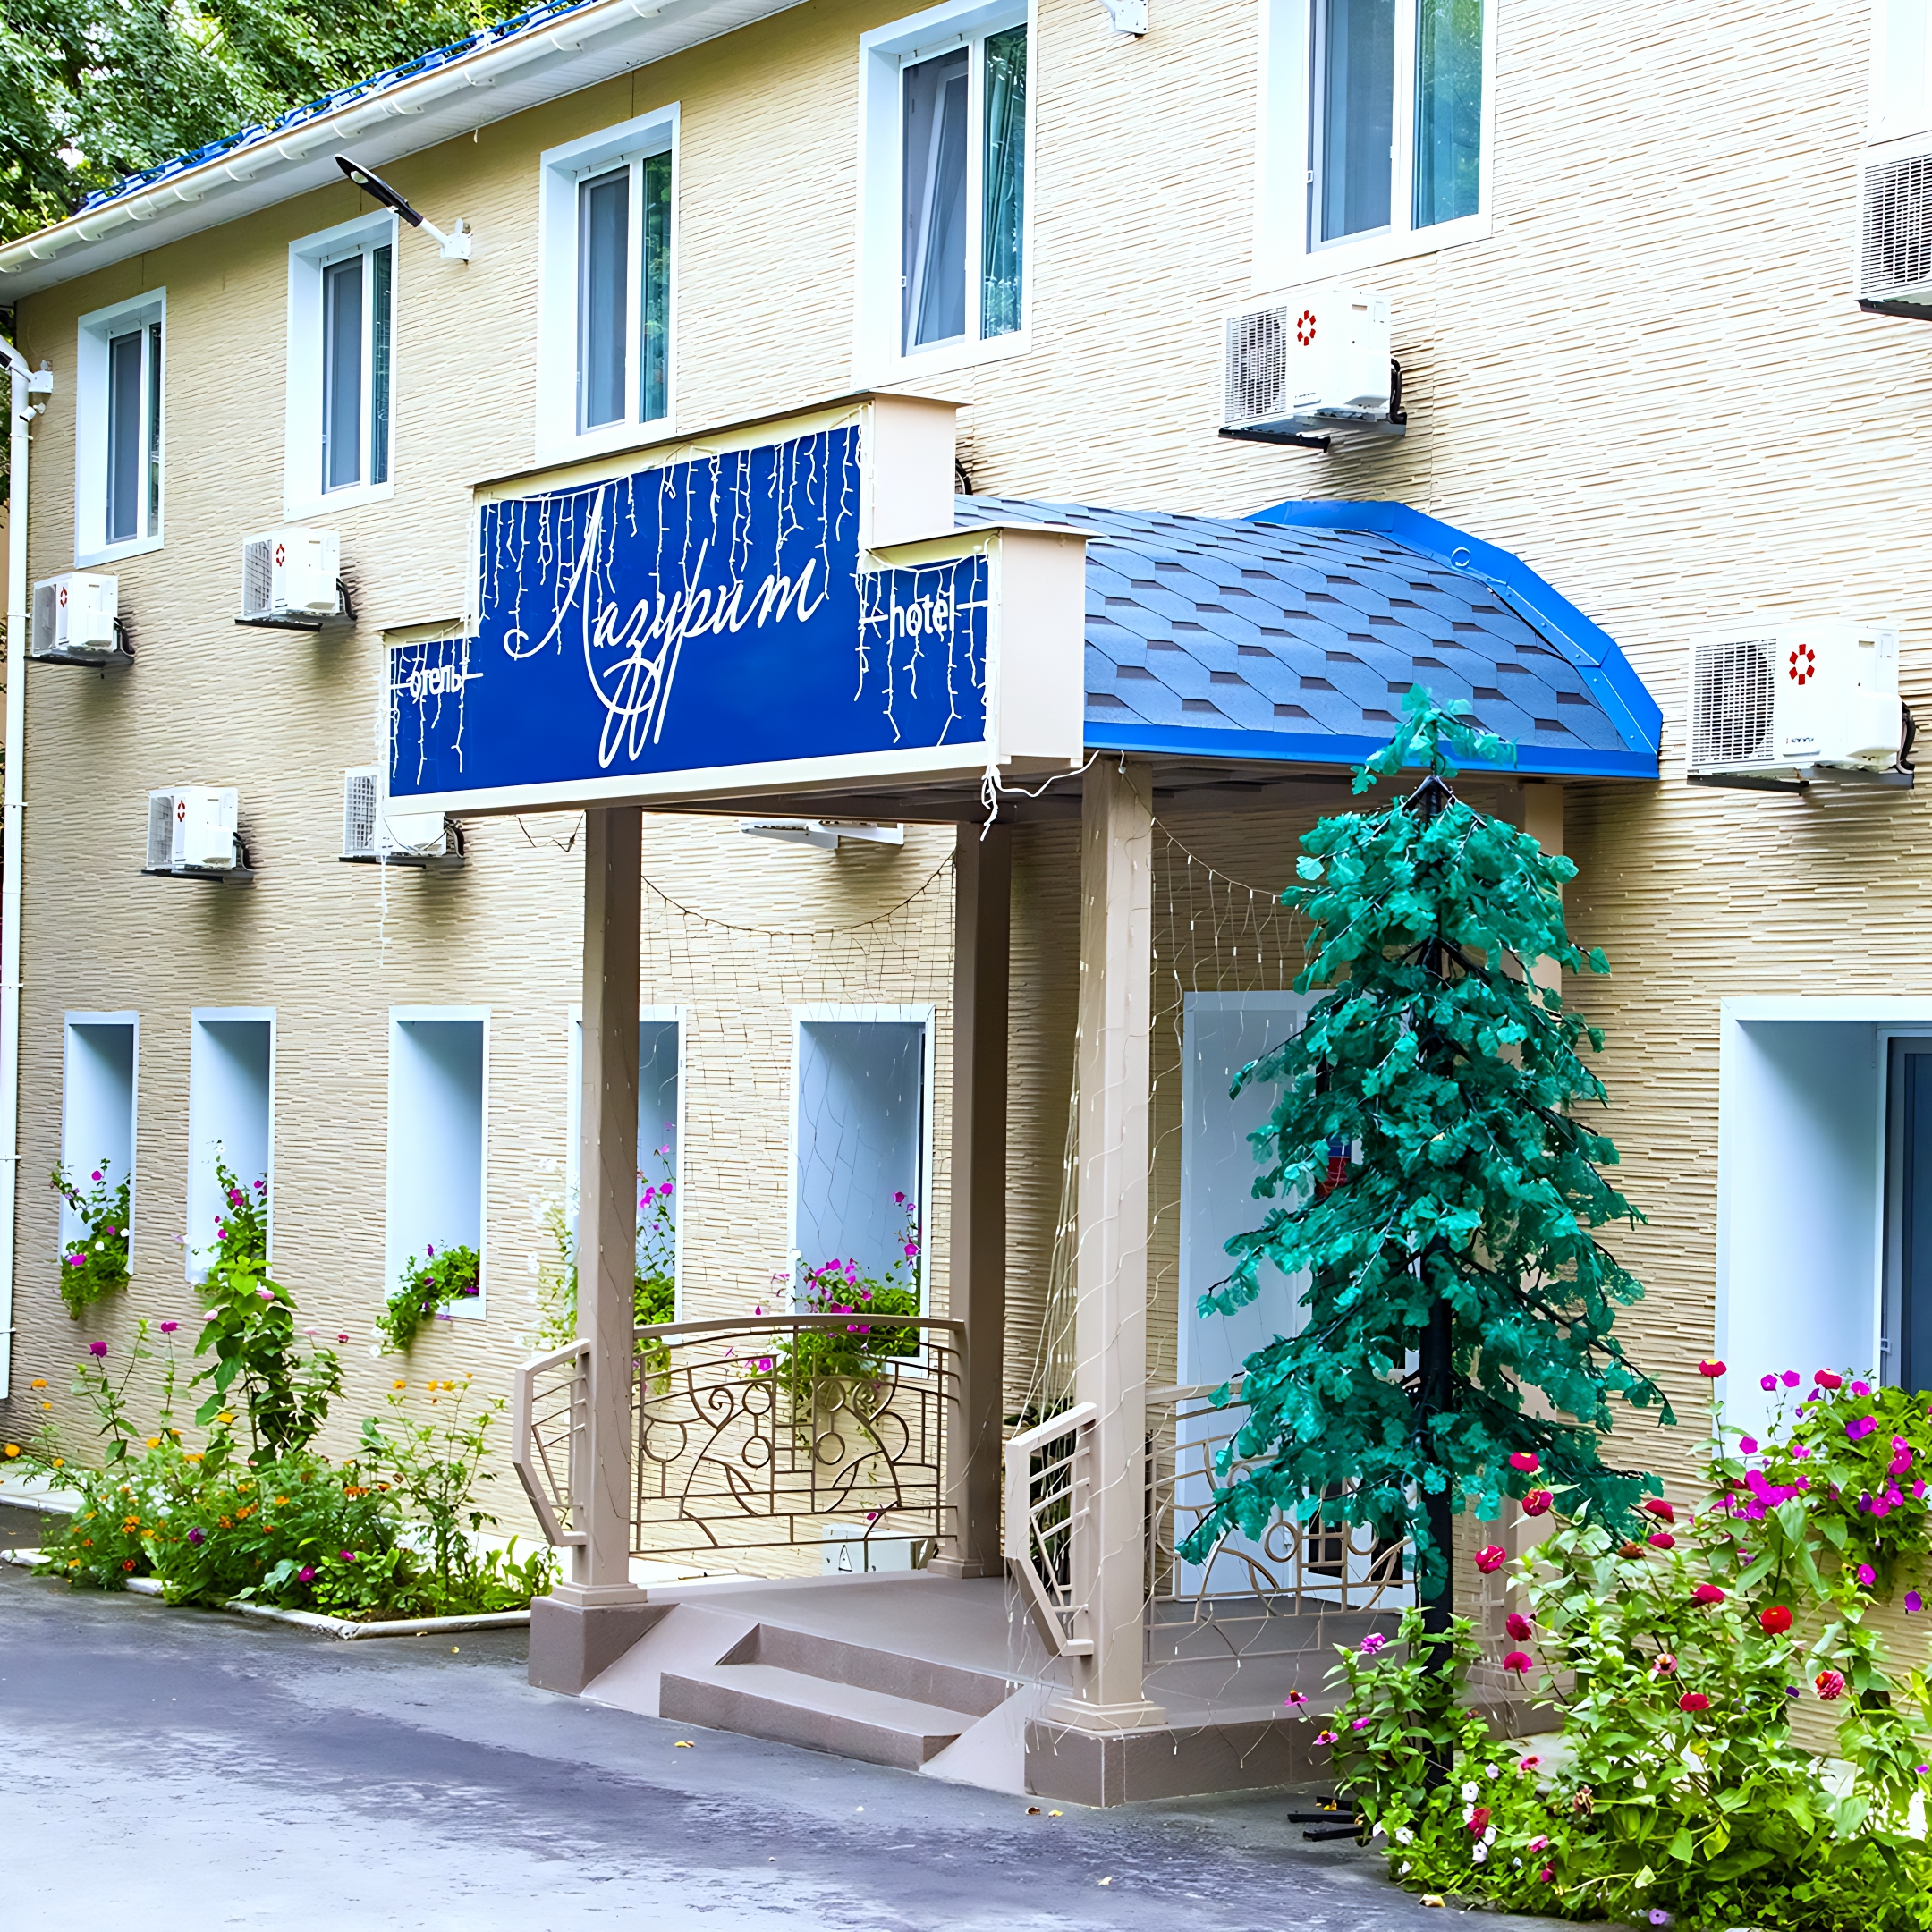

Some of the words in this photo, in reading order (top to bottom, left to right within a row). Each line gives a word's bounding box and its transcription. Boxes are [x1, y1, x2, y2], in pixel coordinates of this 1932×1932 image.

[504, 485, 823, 768] Лазурит
[889, 584, 955, 638] hotel
[409, 665, 464, 698] отель
